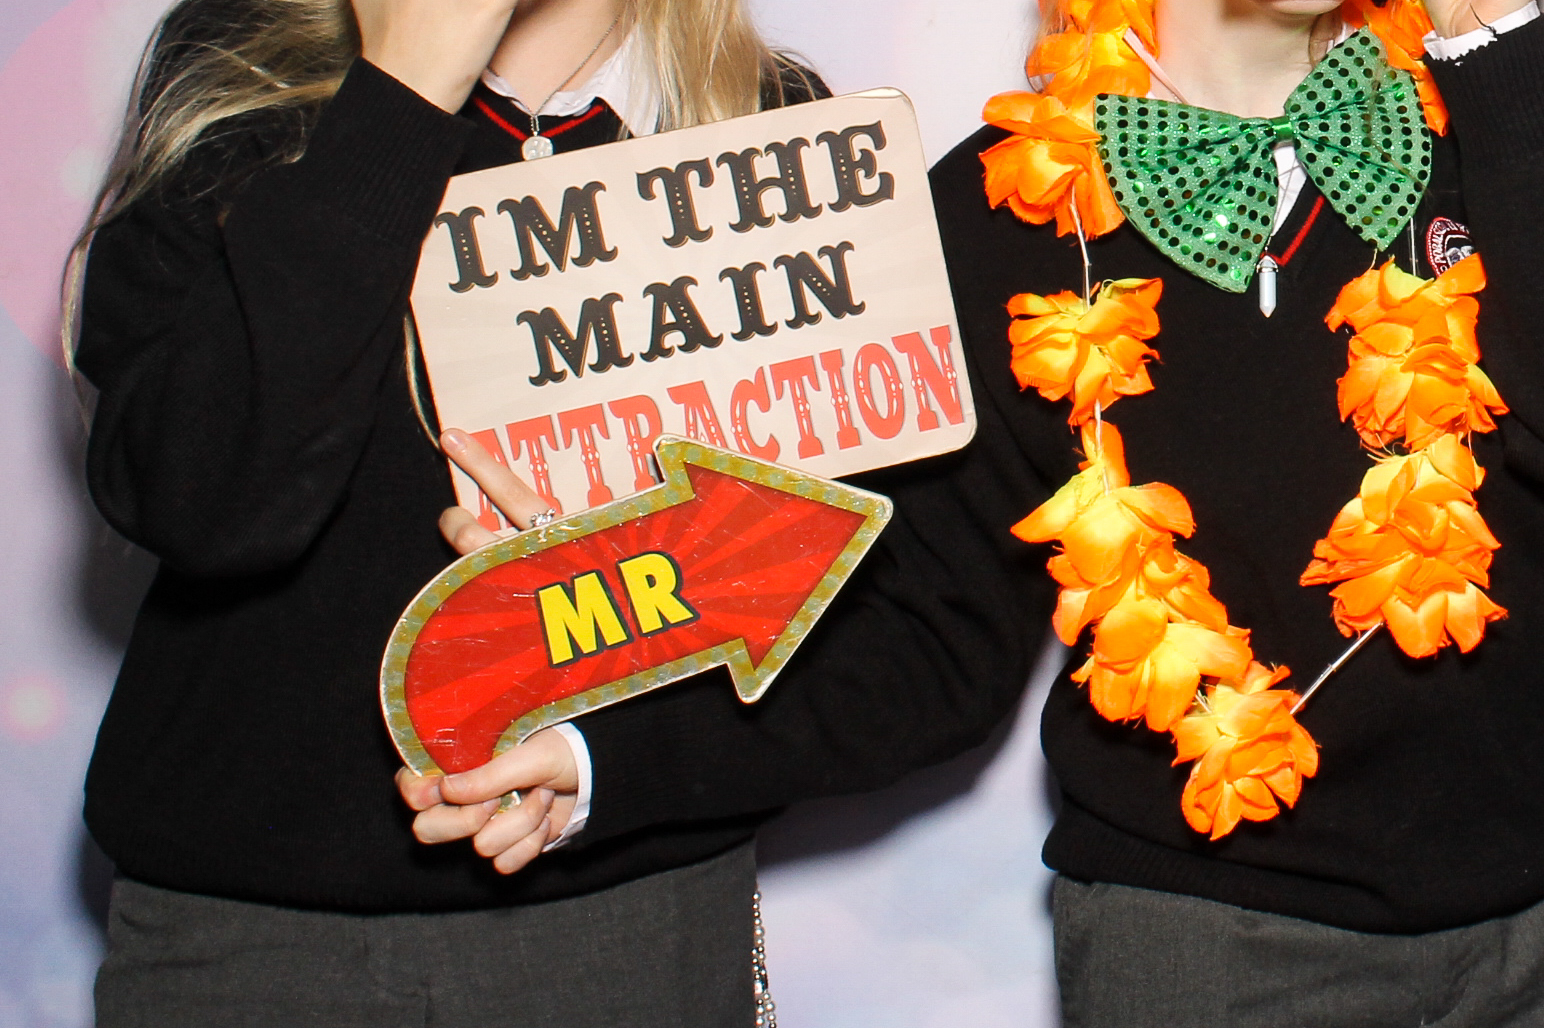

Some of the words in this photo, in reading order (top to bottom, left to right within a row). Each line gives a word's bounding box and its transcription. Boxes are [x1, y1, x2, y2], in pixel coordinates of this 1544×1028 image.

[433, 181, 619, 293] IM
[636, 119, 894, 248] THE
[516, 240, 866, 387] MAIN
[535, 551, 699, 668] MR
